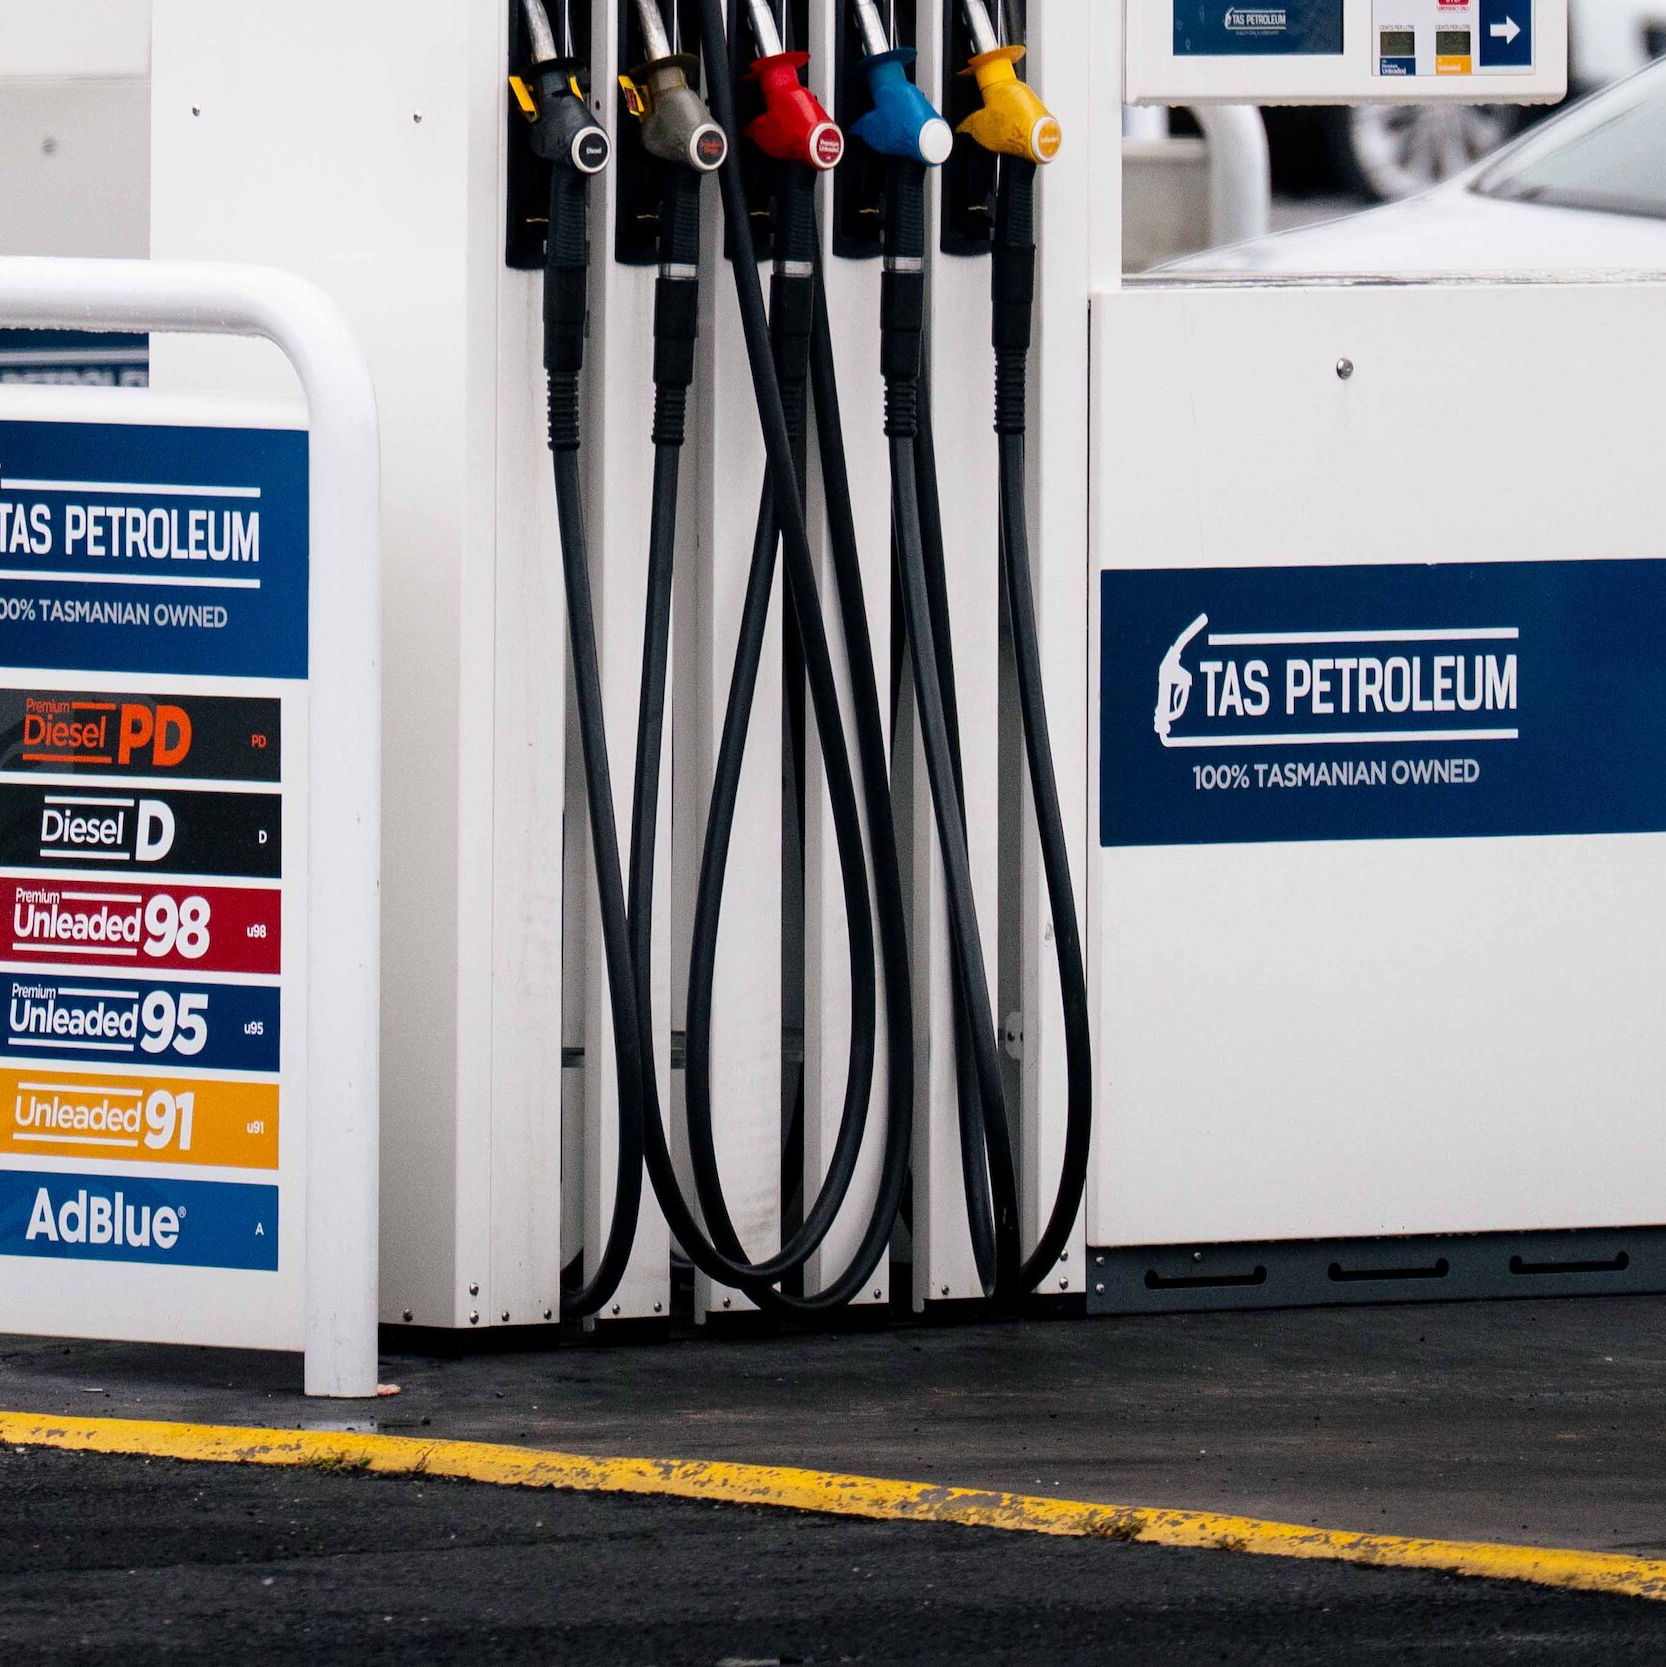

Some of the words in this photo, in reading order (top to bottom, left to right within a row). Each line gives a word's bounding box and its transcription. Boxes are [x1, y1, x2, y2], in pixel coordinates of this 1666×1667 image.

[1232, 14, 1245, 24] TAS
[1246, 14, 1286, 25] PETROLEUM
[586, 146, 602, 154] Diesel
[64, 505, 260, 562] PETROLEUM
[39, 599, 150, 625] TASMANIAN
[153, 604, 228, 629] OWNED
[1199, 660, 1270, 717] TAS
[1285, 654, 1517, 714] PETROLEUM
[26, 697, 70, 713] Premium
[23, 713, 106, 748] Diesel
[117, 703, 192, 766] PD
[251, 735, 267, 748] PD
[1193, 764, 1250, 790] 100%
[1254, 760, 1387, 788] TASMANIAN
[1391, 758, 1480, 785] OWNED
[40, 809, 124, 845] Diesel
[135, 799, 175, 861] D
[258, 830, 267, 844] D
[15, 887, 60, 904] Premium
[13, 904, 142, 943] Unleaded
[143, 893, 211, 959] 98
[246, 924, 267, 939] u98
[11, 983, 56, 1000] Premium
[9, 999, 139, 1039] Unleaded
[139, 990, 209, 1056] 95
[243, 1021, 264, 1036] u95
[14, 1094, 142, 1133] Unleaded
[143, 1089, 195, 1151] 91
[246, 1120, 265, 1135] u91
[254, 1222, 264, 1236] A
